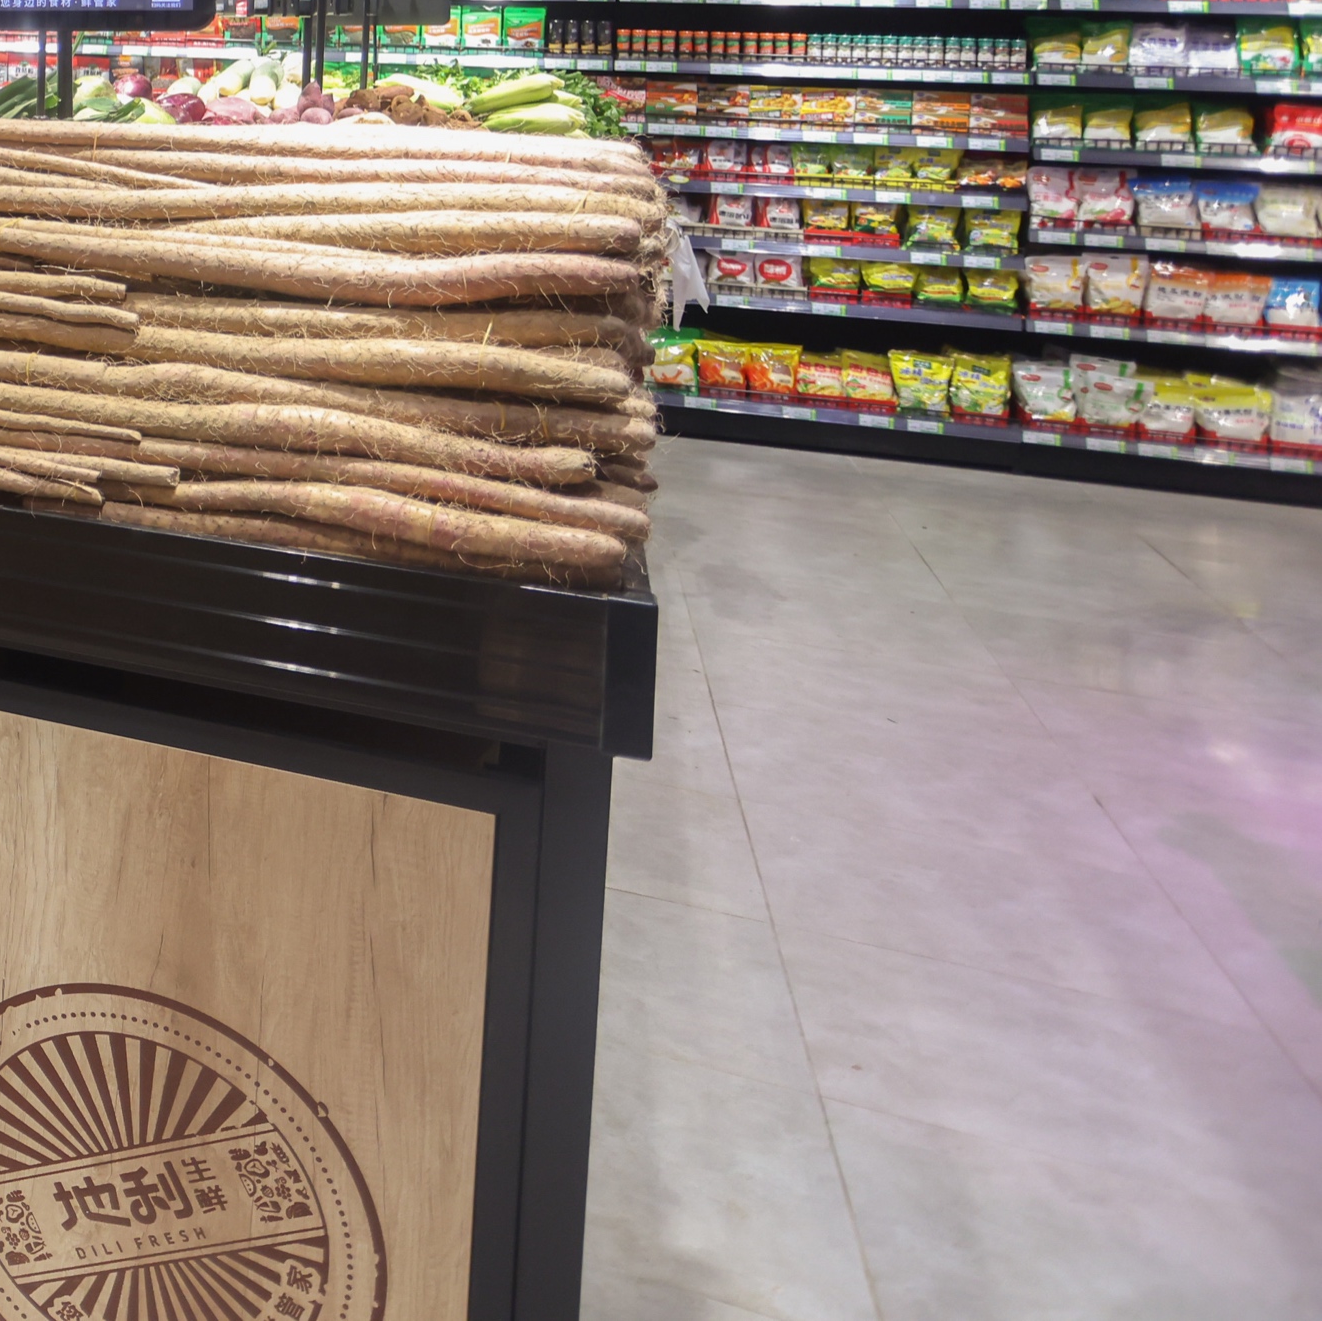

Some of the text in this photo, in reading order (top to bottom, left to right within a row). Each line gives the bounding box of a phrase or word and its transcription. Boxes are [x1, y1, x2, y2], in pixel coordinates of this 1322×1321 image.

[52, 1156, 228, 1232] 地利生鲜
[75, 1227, 208, 1261] DILI FRESH
